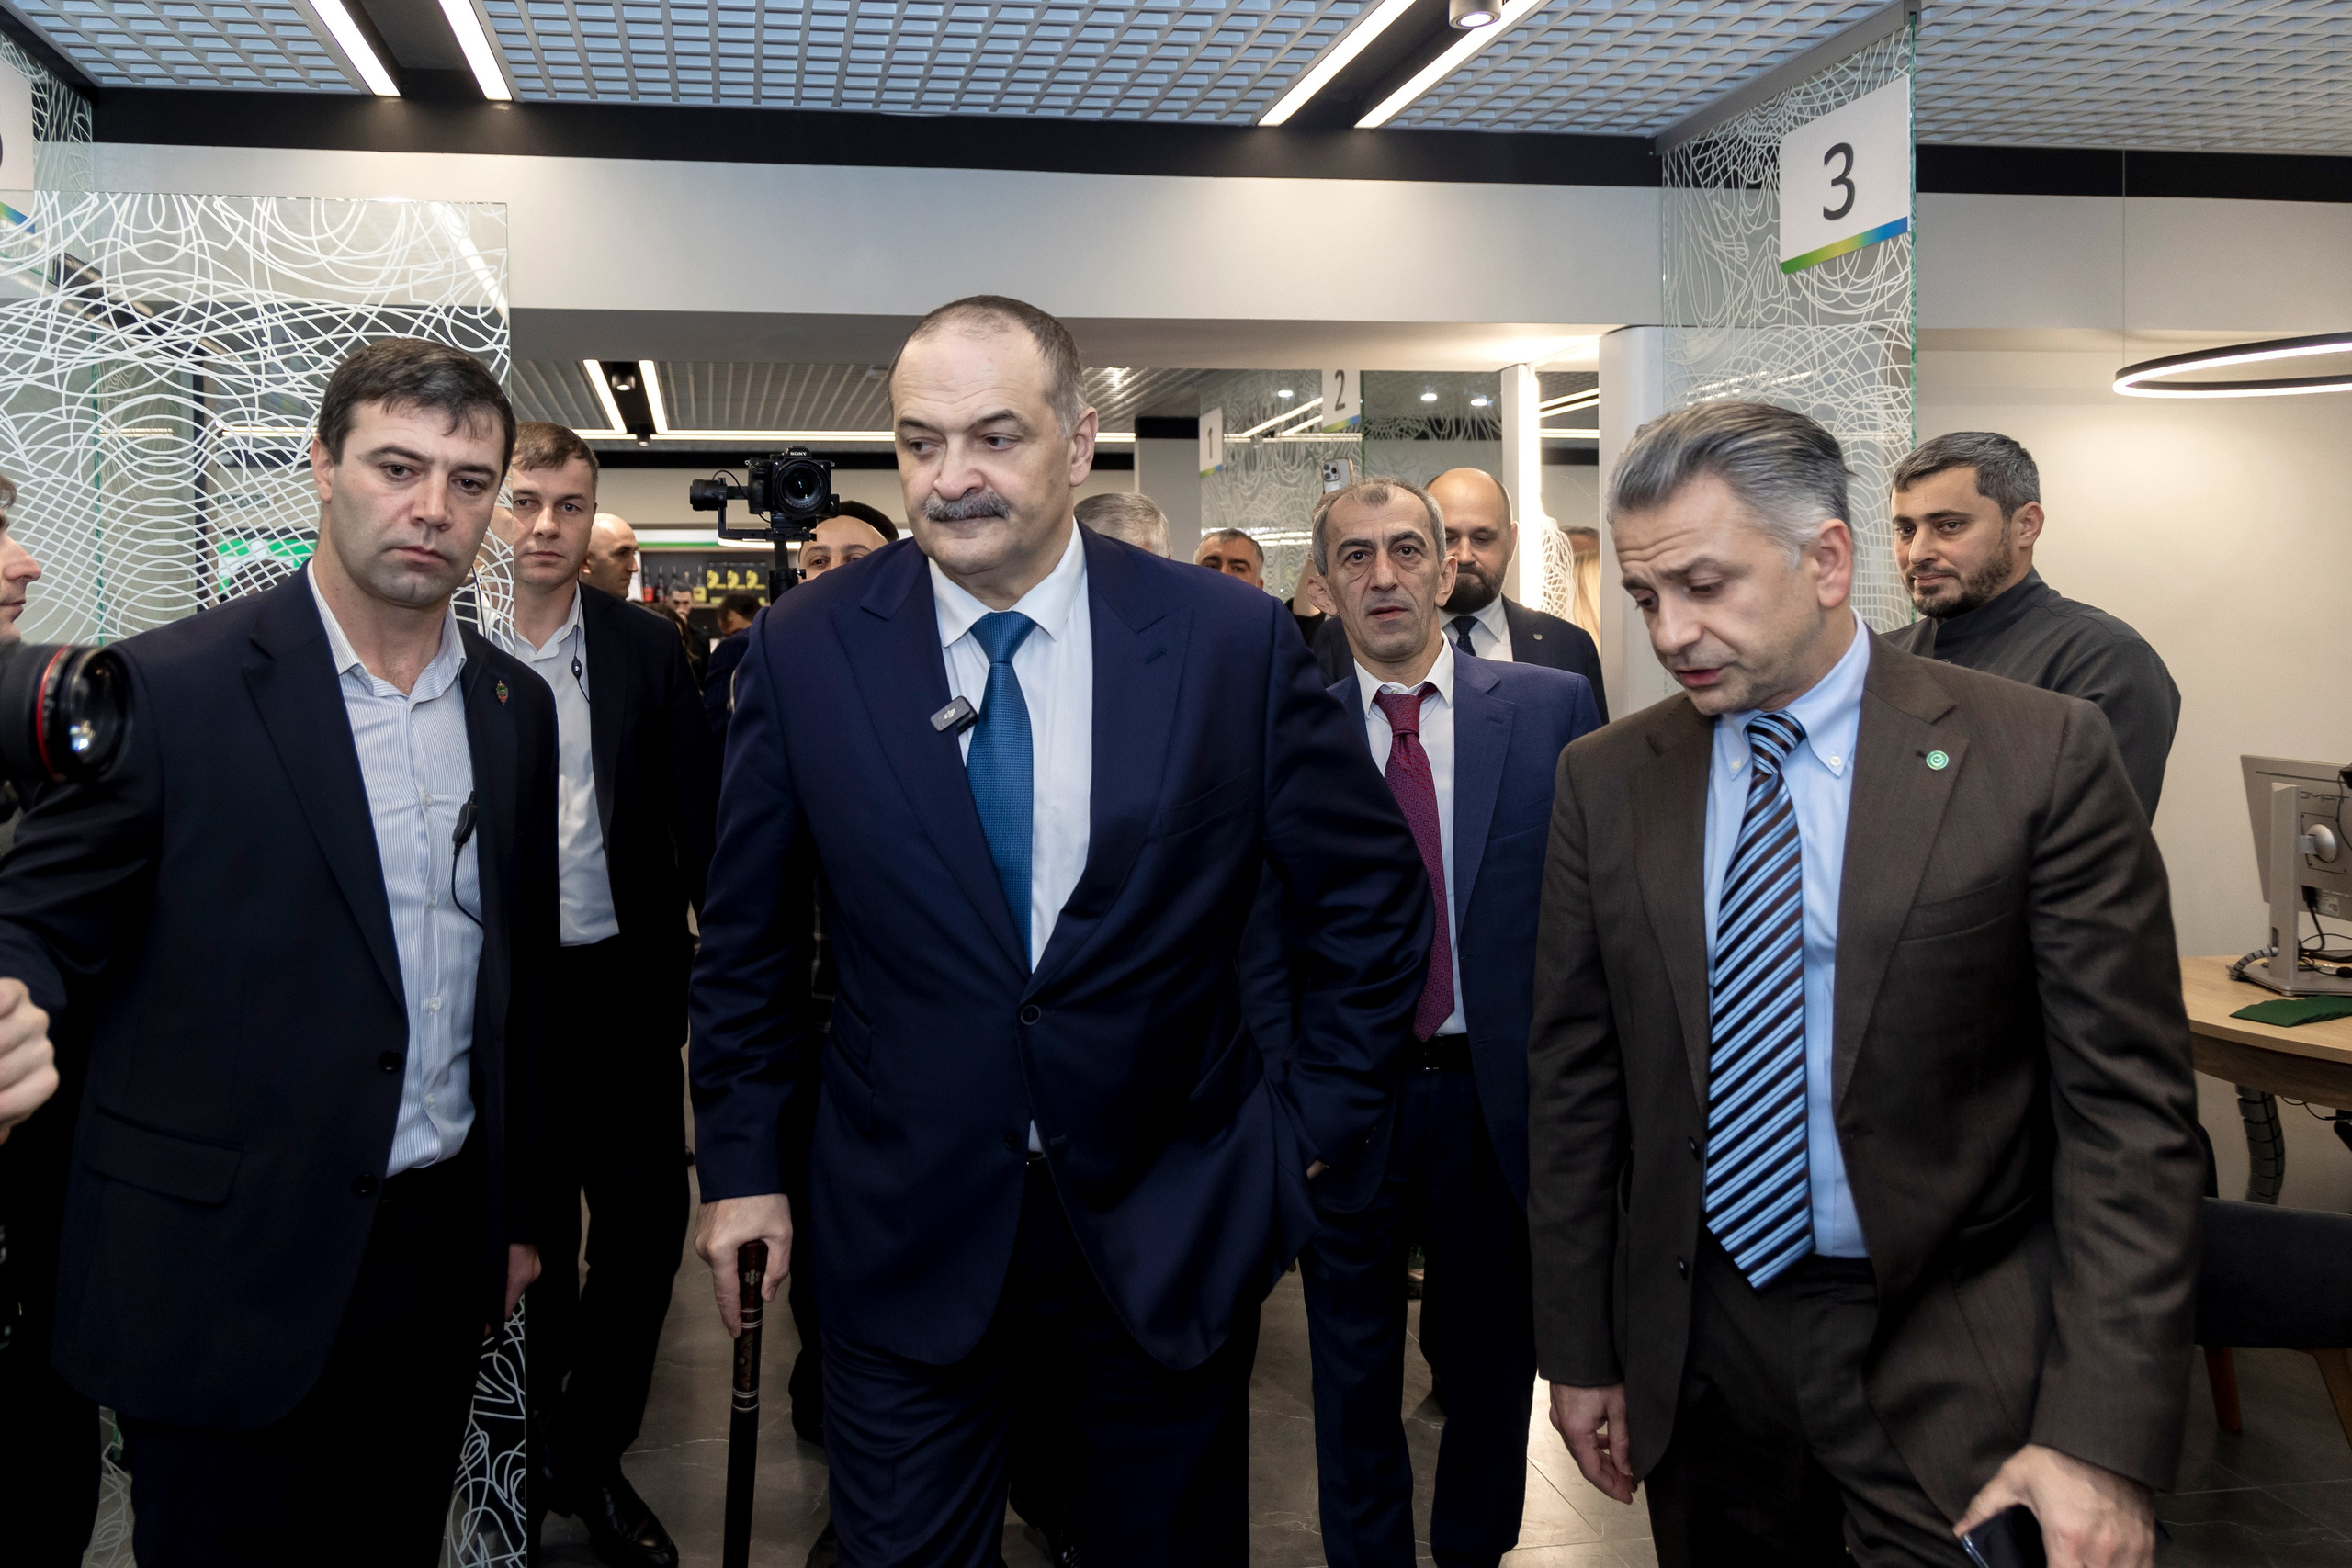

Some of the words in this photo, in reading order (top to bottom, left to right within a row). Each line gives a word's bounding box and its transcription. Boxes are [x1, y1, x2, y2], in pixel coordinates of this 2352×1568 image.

[1823, 141, 1855, 220] 3
[1334, 368, 1346, 412] 2
[1207, 426, 1213, 459] 1
